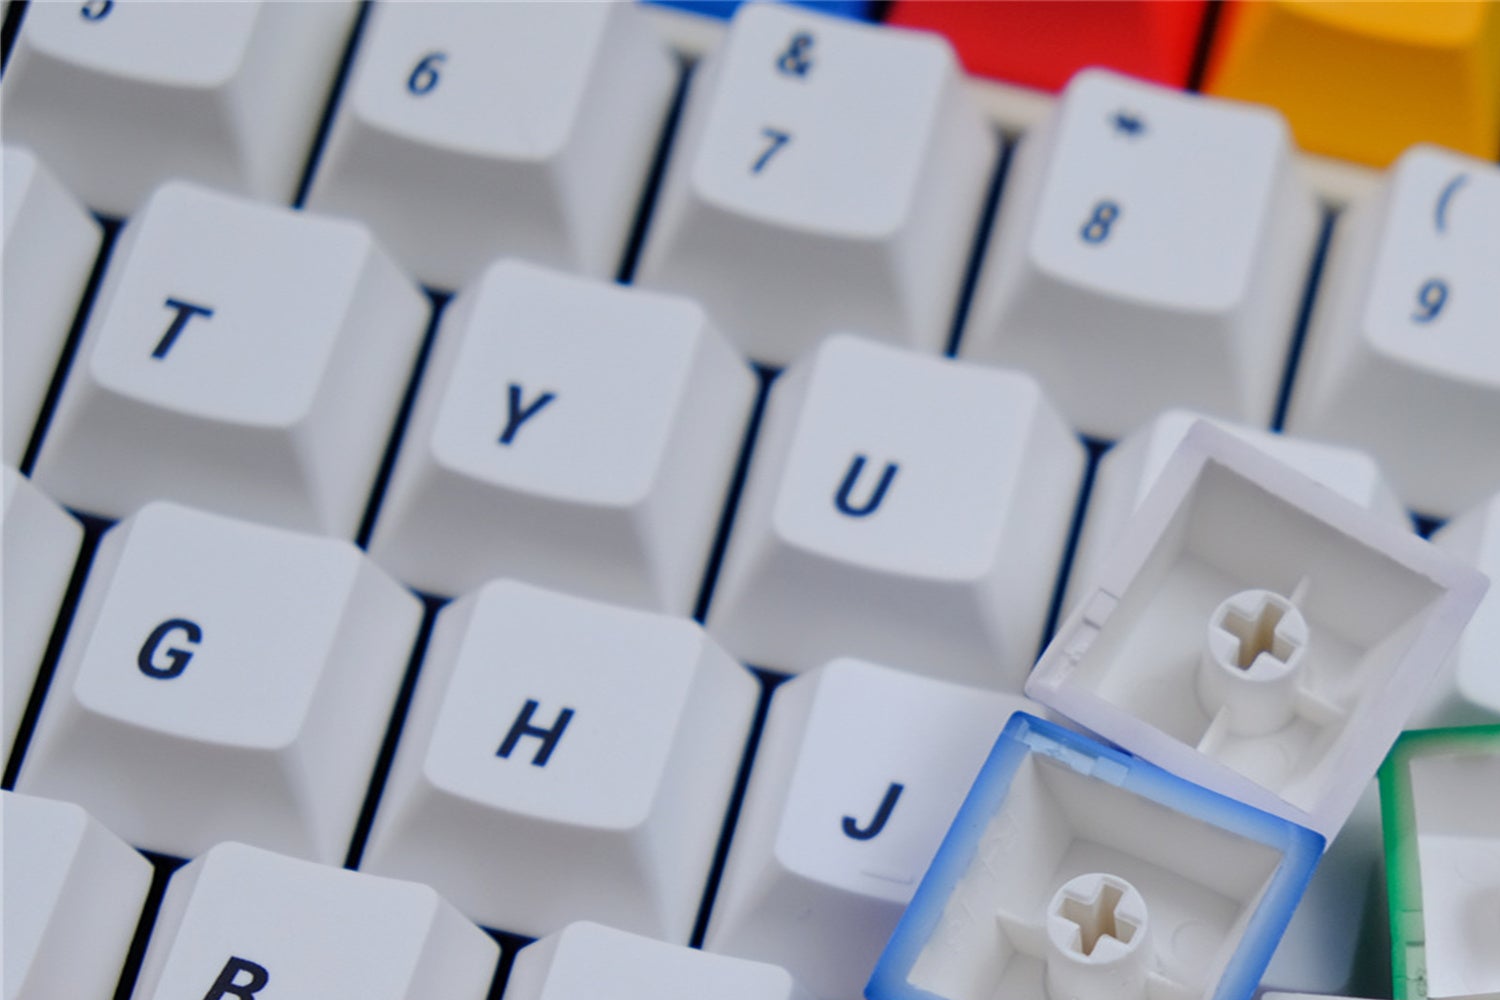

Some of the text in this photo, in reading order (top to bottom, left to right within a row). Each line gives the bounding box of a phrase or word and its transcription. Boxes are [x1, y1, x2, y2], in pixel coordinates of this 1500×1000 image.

[406, 53, 444, 96] 6
[775, 33, 815, 78] &
[750, 127, 791, 175] 7
[1079, 200, 1121, 245] 8
[1432, 173, 1467, 233] (
[151, 297, 214, 360] T
[1411, 279, 1449, 325] 9
[498, 383, 556, 446] Y
[833, 455, 899, 518] U
[136, 617, 203, 681] G
[495, 698, 575, 768] H
[841, 782, 905, 842] J
